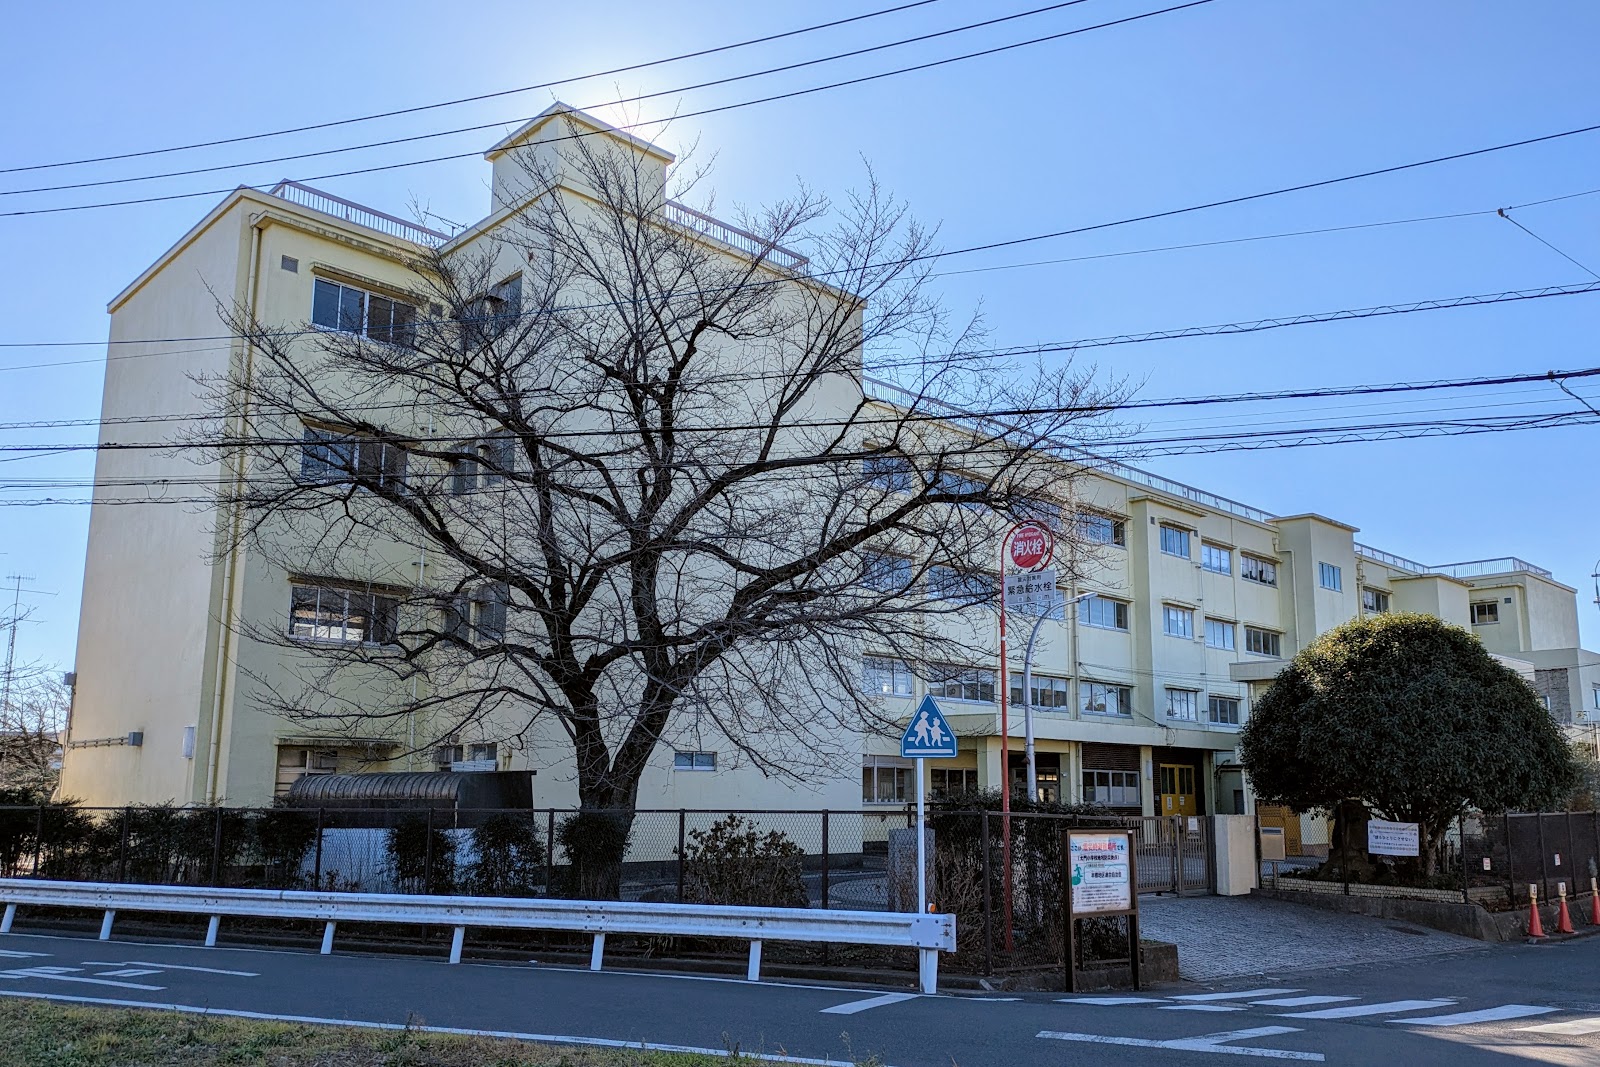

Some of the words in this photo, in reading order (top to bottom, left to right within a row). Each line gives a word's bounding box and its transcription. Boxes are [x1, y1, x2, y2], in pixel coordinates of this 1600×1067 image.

[1013, 538, 1043, 557] 消火栓
[1007, 581, 1052, 596] 緊急給水栓
